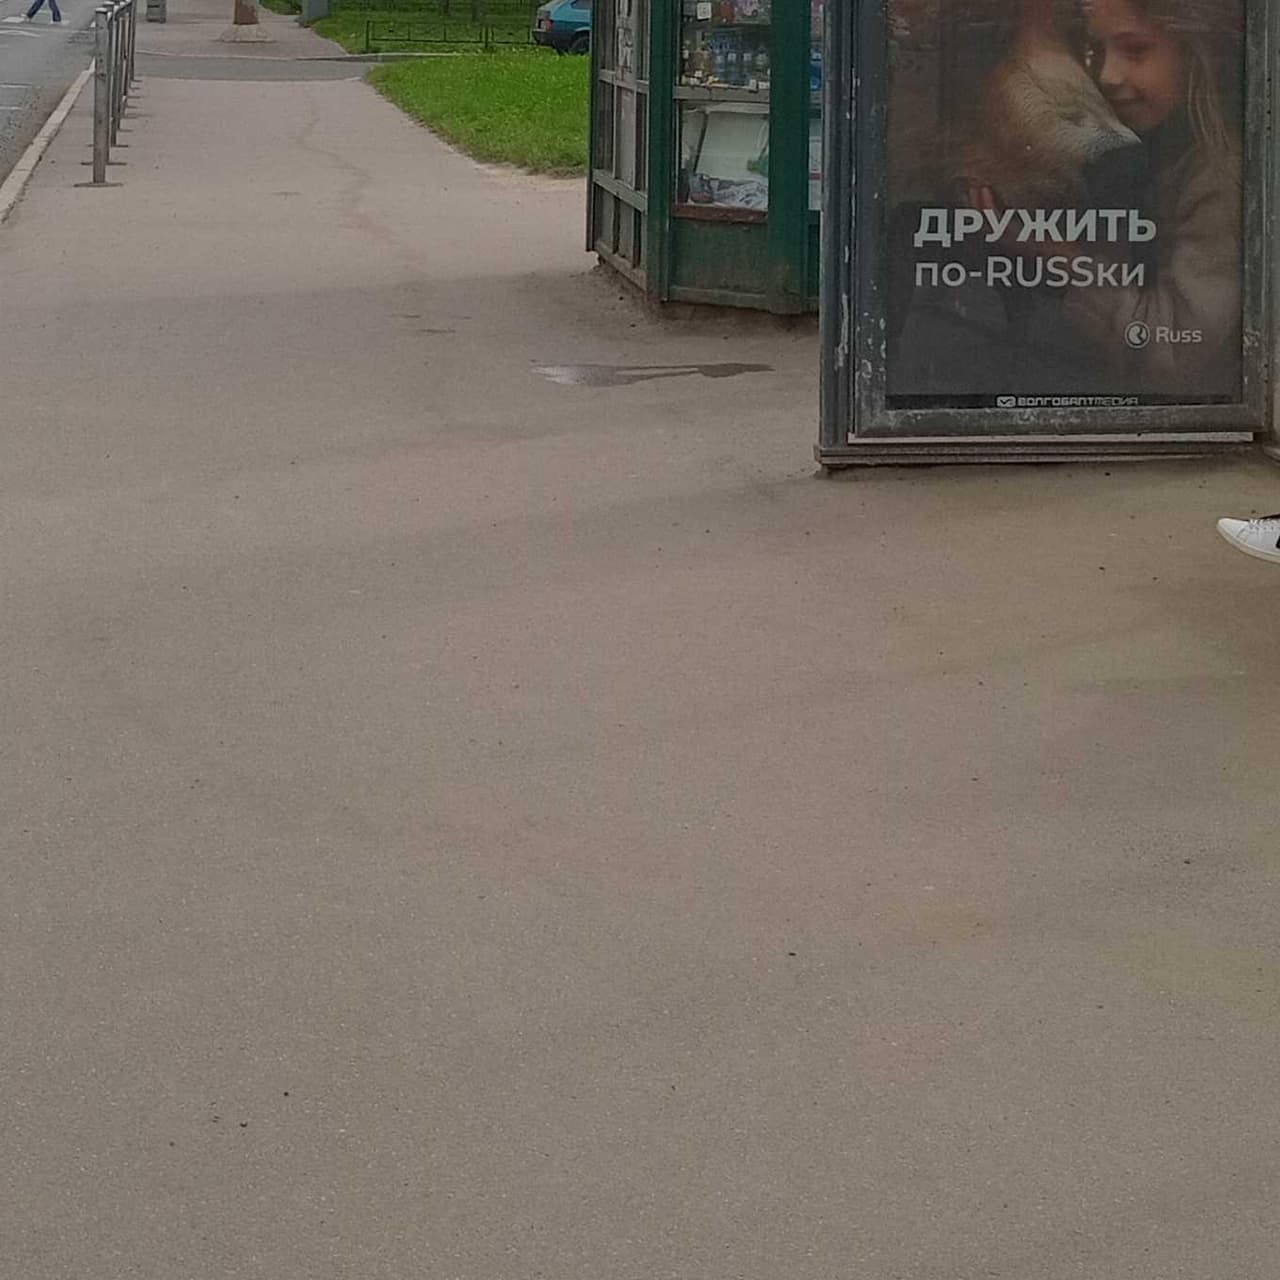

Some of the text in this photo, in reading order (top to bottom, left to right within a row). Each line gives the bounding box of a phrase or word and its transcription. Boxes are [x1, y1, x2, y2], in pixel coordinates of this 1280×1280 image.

[913, 208, 1157, 248] ДРУЖИТЬ
[915, 255, 1145, 287] по-RUSSки
[1155, 326, 1203, 343] Russ
